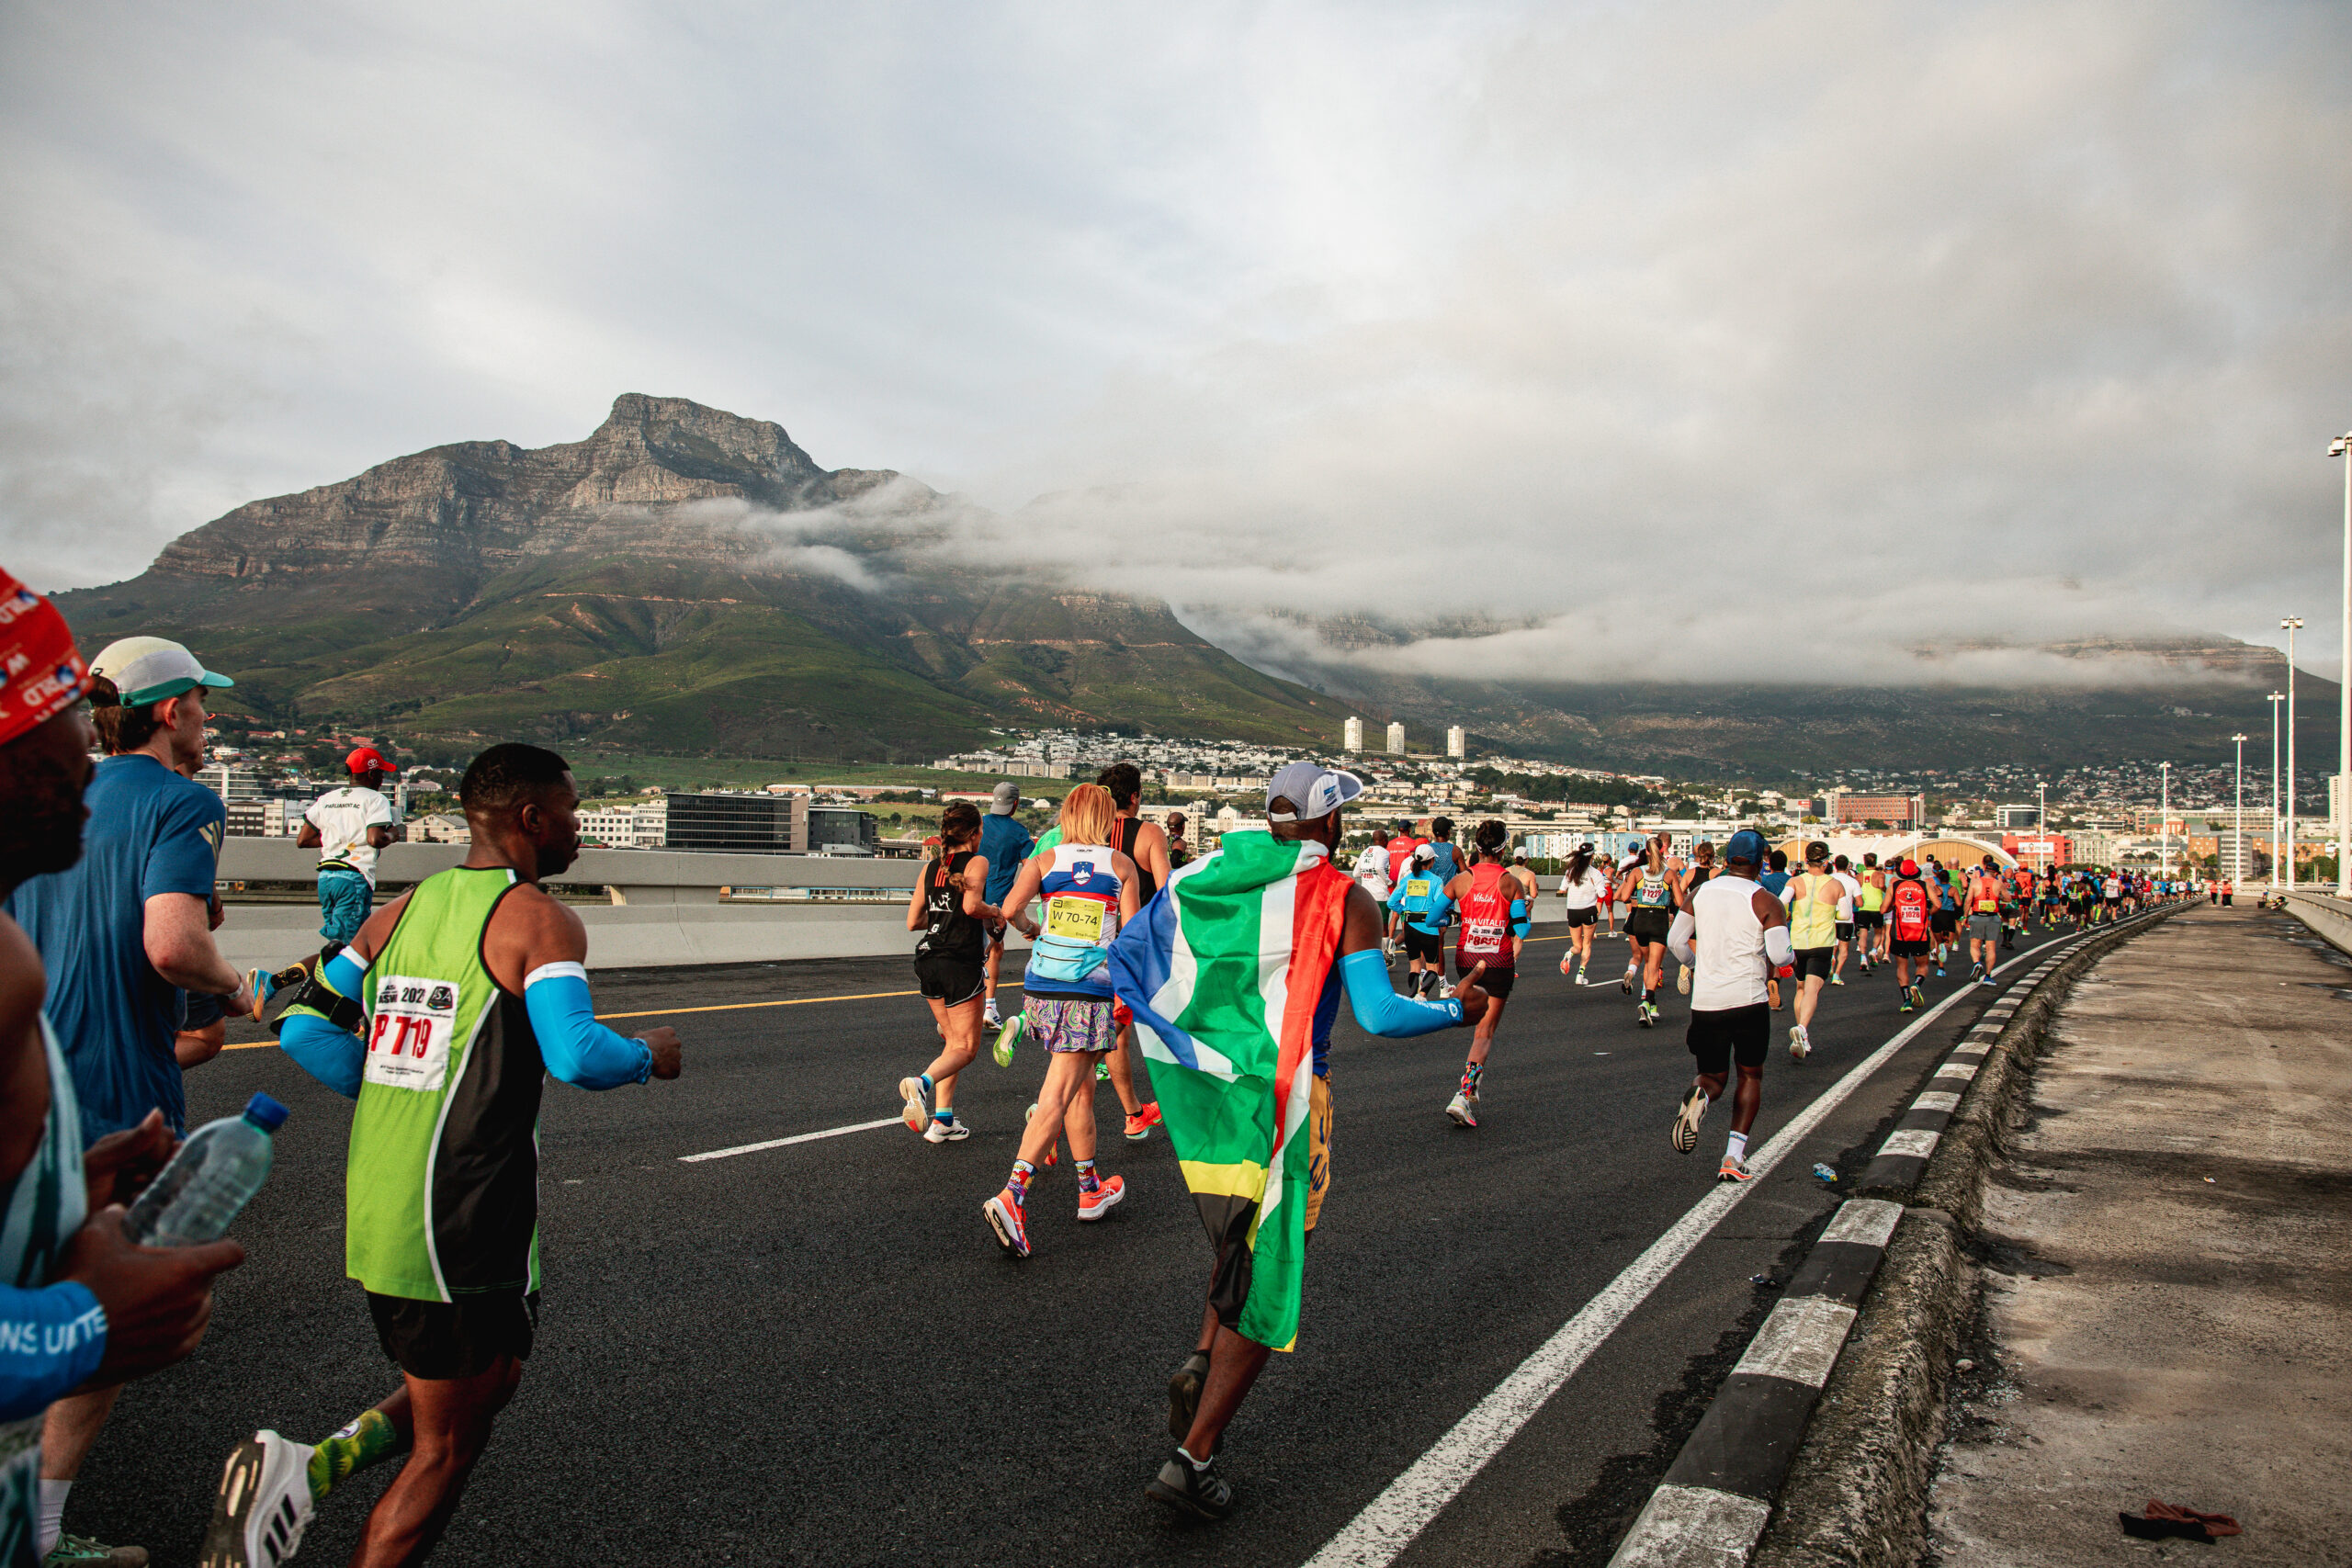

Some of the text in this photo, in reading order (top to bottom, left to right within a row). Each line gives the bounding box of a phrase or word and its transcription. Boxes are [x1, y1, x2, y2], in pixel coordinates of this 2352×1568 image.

[1473, 892, 1496, 906] Vitality
[1053, 910, 1098, 926] W 70-74
[401, 987, 426, 1004] 202
[370, 1014, 433, 1059] P 719
